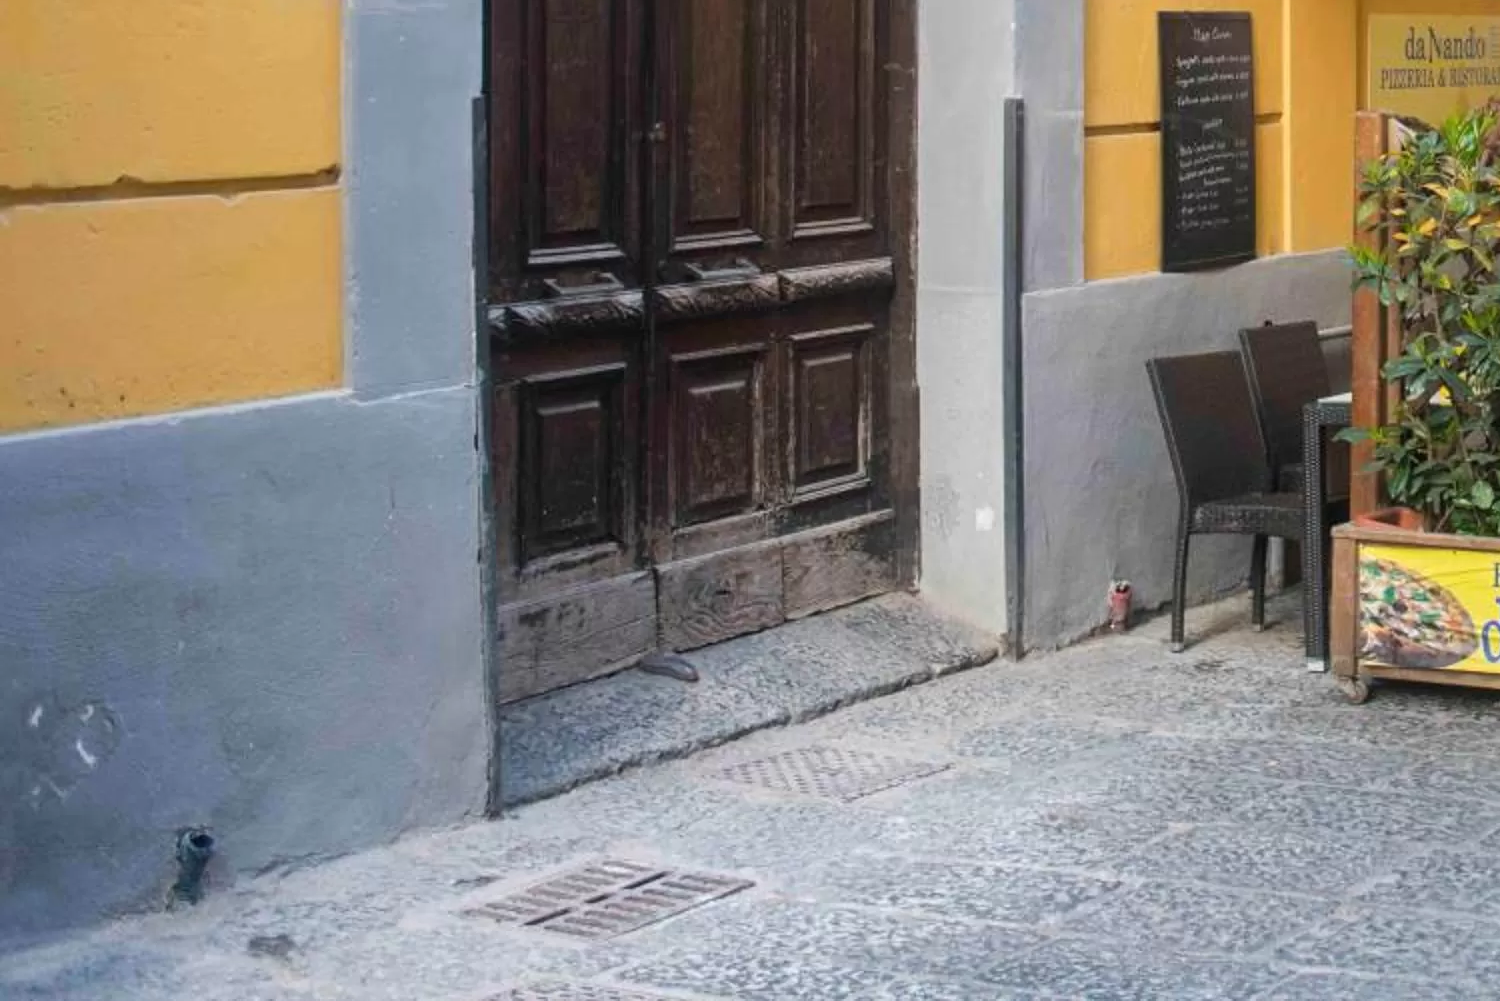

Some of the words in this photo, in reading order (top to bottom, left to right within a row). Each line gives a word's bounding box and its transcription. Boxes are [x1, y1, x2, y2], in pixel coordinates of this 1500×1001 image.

[1405, 26, 1427, 60] da
[1428, 26, 1485, 62] Nando
[1379, 68, 1436, 89] PIZZERIA
